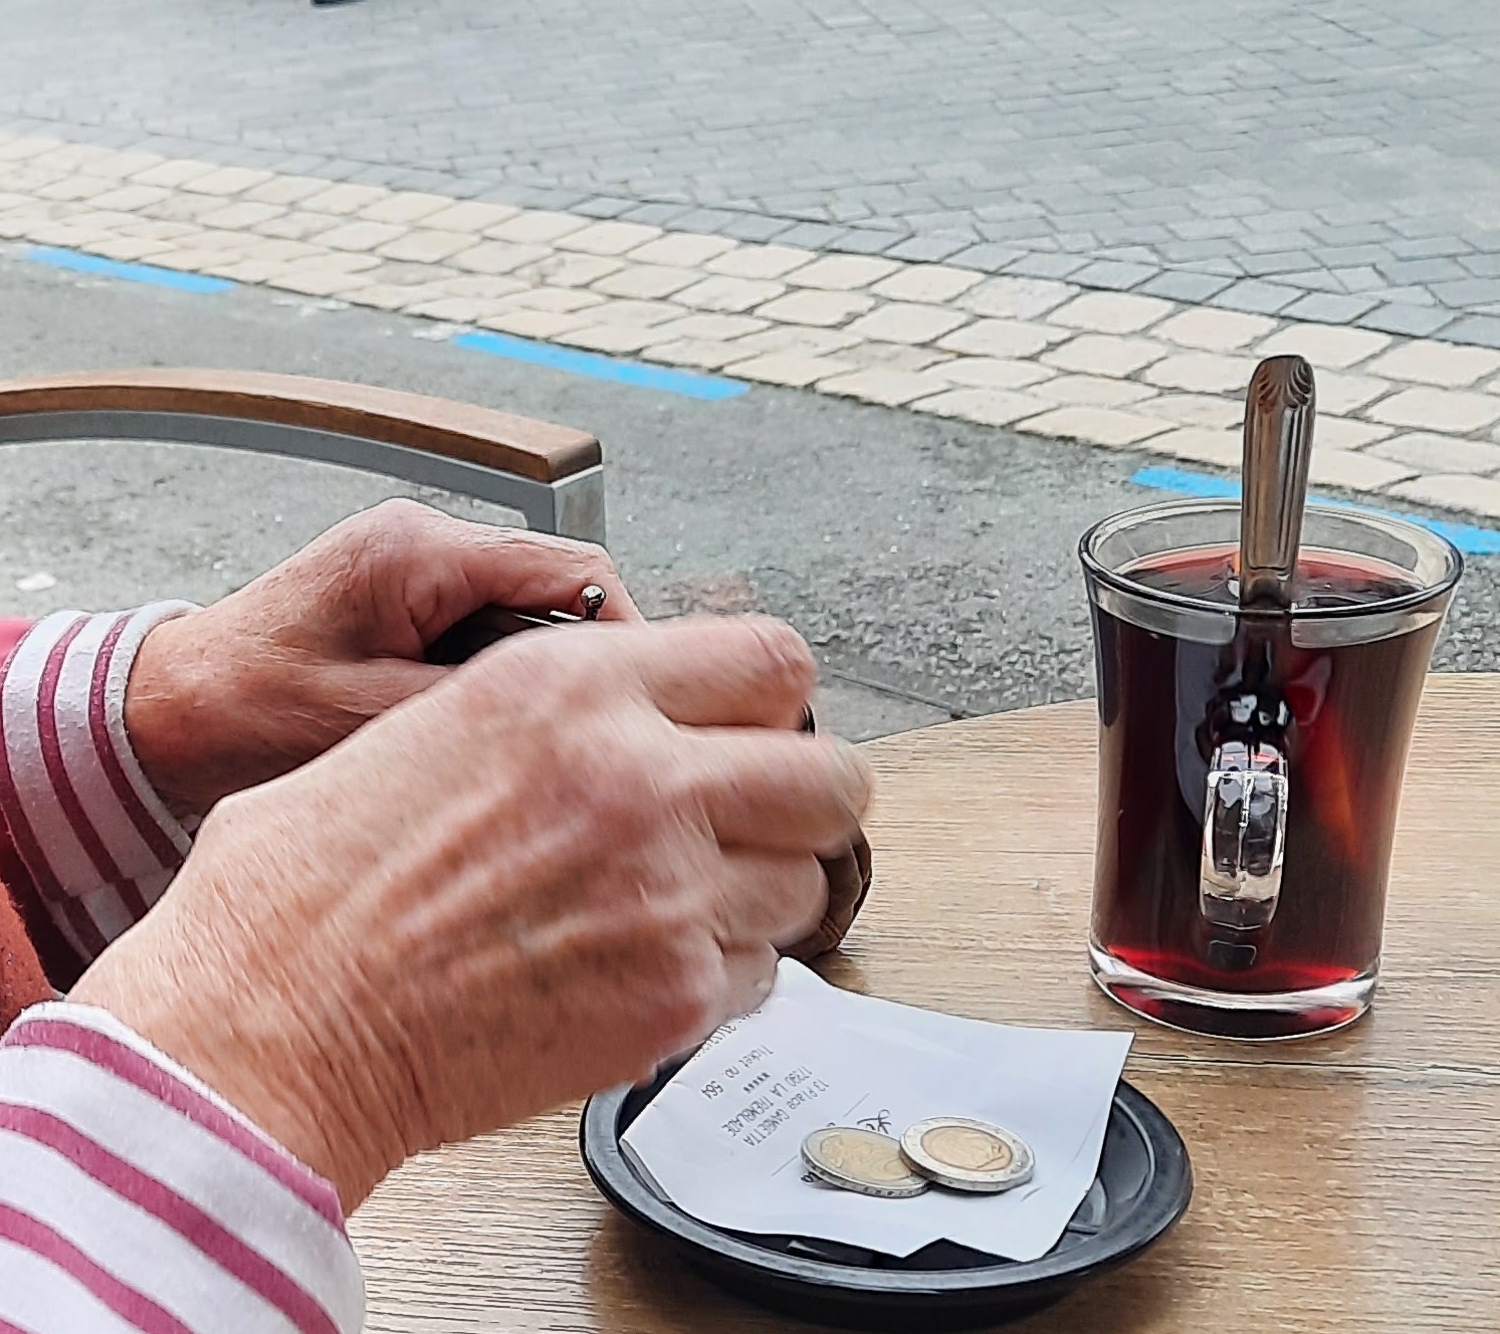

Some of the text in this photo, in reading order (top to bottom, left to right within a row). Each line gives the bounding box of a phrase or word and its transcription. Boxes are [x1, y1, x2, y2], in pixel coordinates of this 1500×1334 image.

[738, 1044, 774, 1069] Ticket
[700, 1079, 725, 1100] 564
[769, 1082, 789, 1098] LA
[720, 1094, 775, 1138] TREMBLADE
[742, 1078, 830, 1147] 13 Place GAMBETTA
